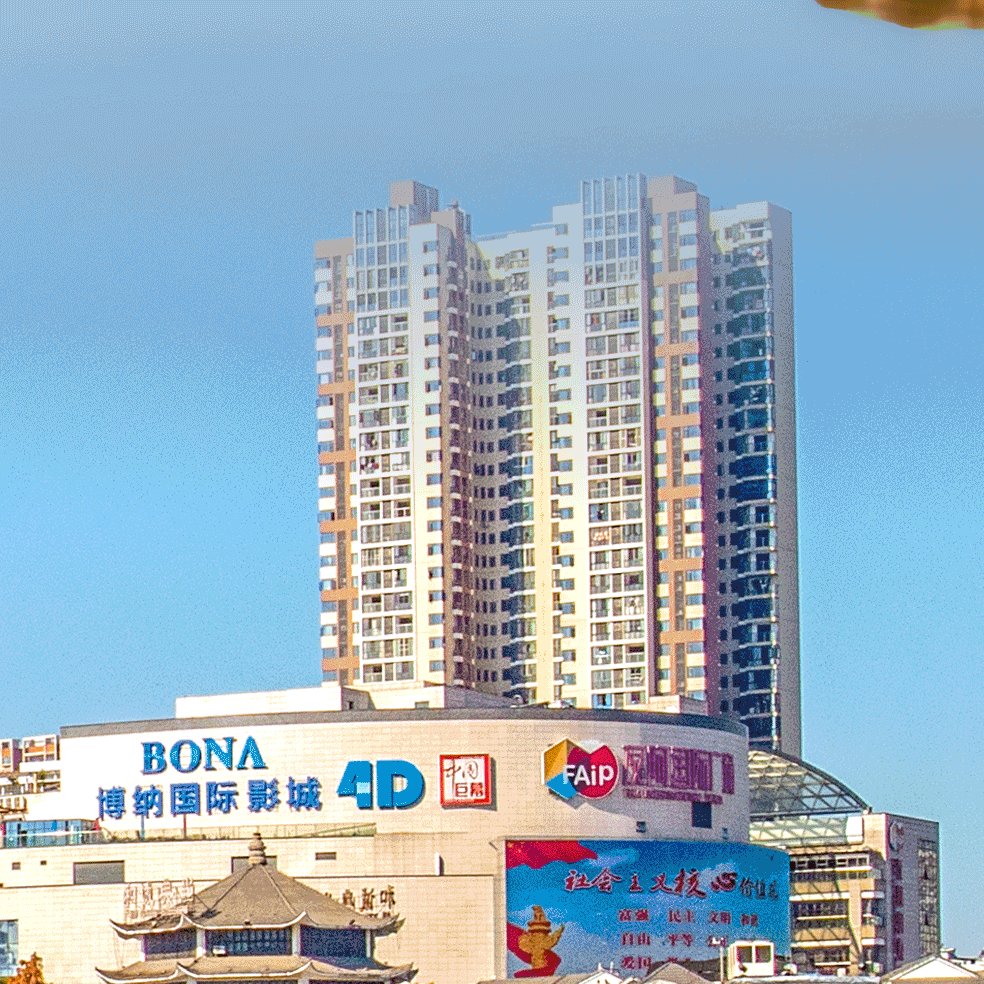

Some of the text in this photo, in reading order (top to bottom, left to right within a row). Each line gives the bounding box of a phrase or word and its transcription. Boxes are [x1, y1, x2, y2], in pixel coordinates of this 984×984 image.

[141, 736, 266, 774] BONA
[97, 775, 323, 820] 博纳国际影城
[336, 759, 426, 809] 4D
[668, 909, 695, 924] 民主
[620, 931, 652, 946] 自由
[667, 932, 695, 948] 平等
